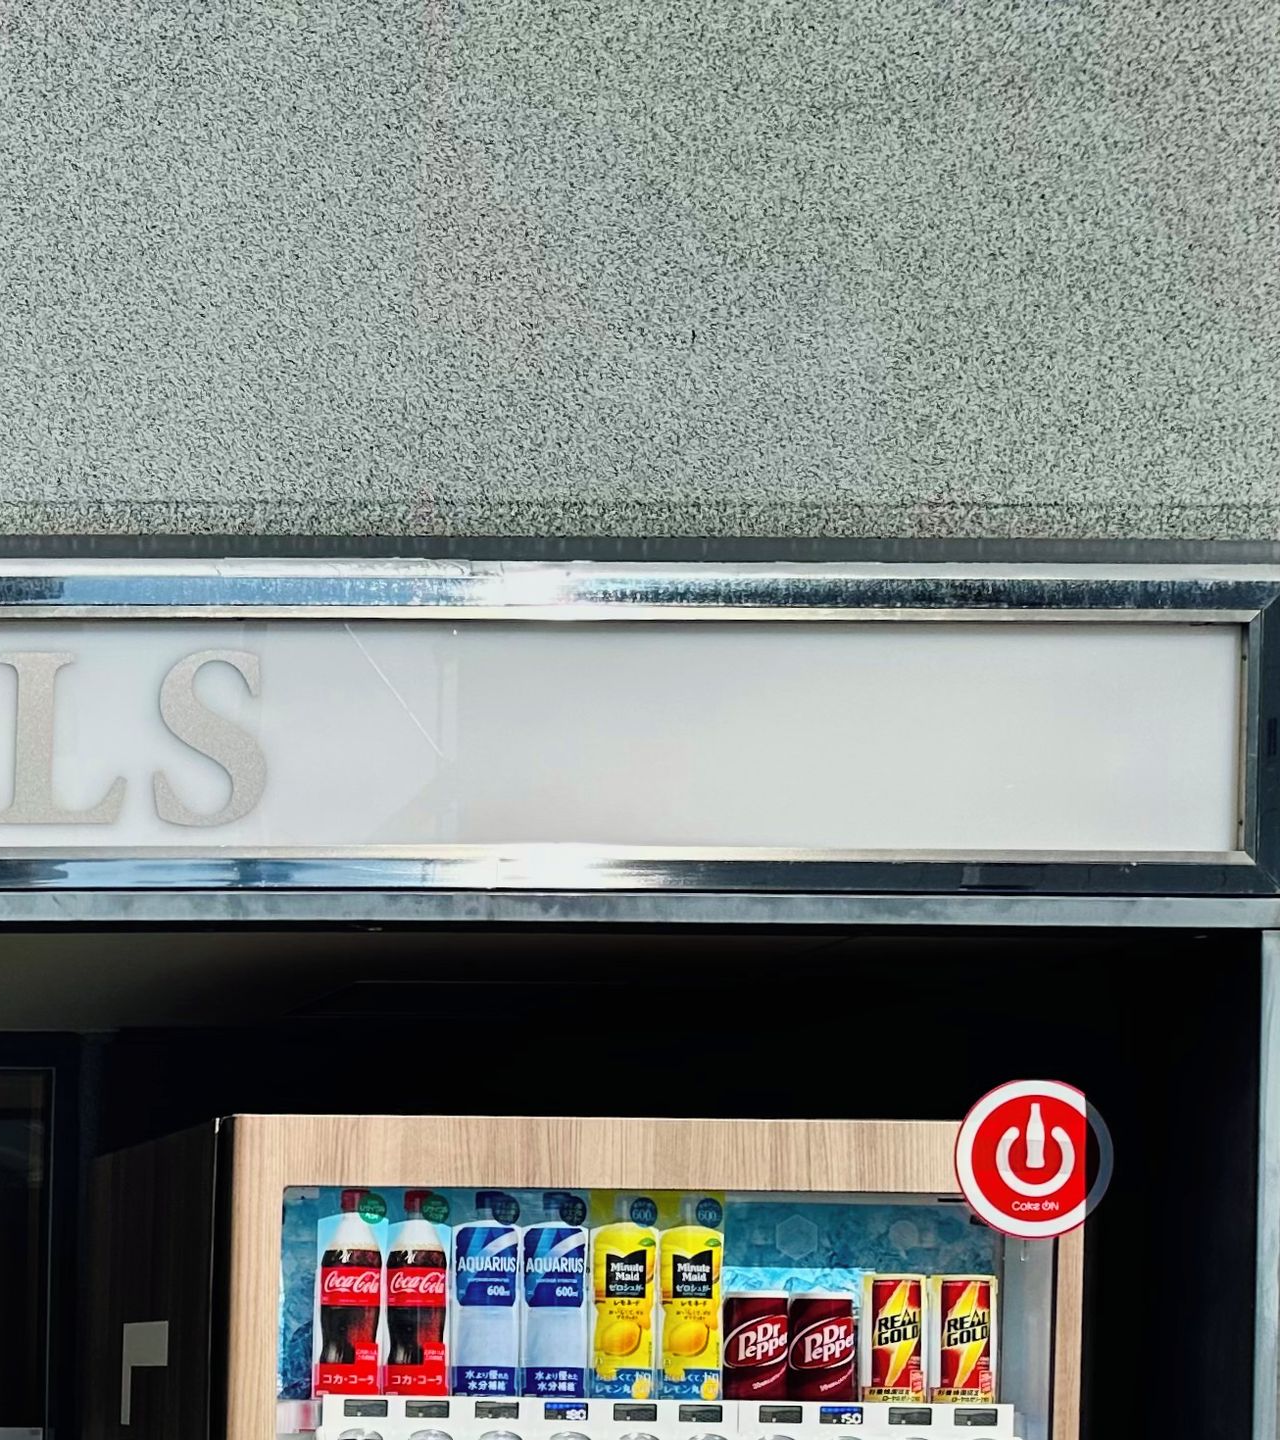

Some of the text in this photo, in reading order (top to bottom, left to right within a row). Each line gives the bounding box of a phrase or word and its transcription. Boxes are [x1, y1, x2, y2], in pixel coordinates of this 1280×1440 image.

[1011, 1200, 1040, 1211] Coke
[457, 1256, 516, 1273] AQUARIUS
[525, 1256, 584, 1273] AQUARIUS
[610, 1262, 644, 1273] Minute
[677, 1262, 711, 1273] Minute
[615, 1271, 640, 1282] Maid
[681, 1272, 707, 1283] Maid
[878, 1309, 922, 1332] REAL
[946, 1310, 990, 1332] REAL
[757, 1323, 781, 1340] Dr
[823, 1324, 847, 1341] Dr
[877, 1327, 919, 1347] GOLD
[946, 1328, 990, 1347] GOLD
[322, 1373, 375, 1385] コカ・コーラ
[391, 1374, 443, 1386] コカ・コーラ
[467, 1380, 507, 1392] 水分補給
[537, 1380, 576, 1392] 水分補給
